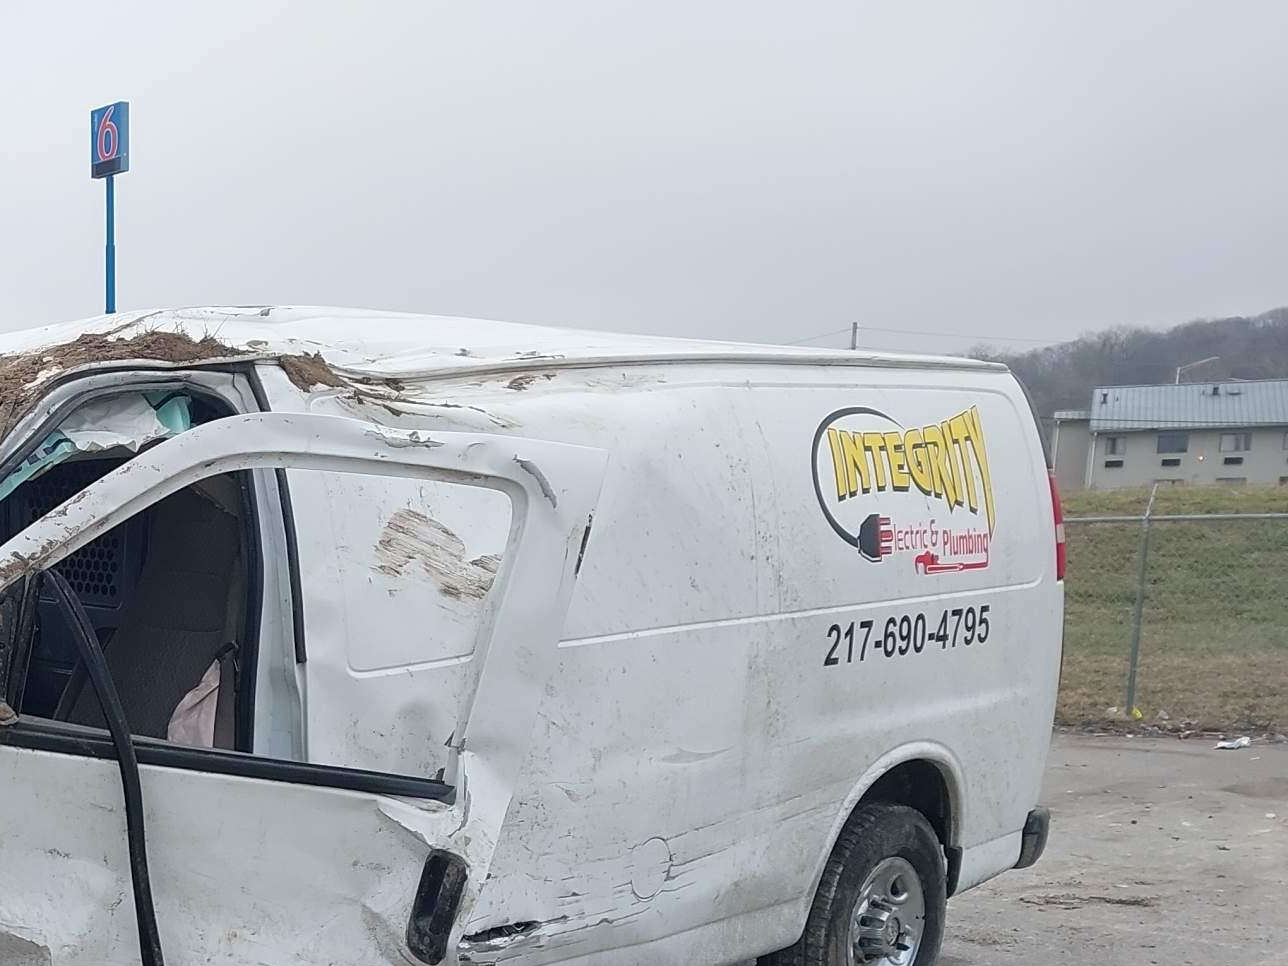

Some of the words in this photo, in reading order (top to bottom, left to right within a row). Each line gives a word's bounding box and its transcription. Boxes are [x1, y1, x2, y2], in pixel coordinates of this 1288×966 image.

[97, 105, 119, 161] 6
[826, 404, 996, 542] INTEGRITY
[942, 528, 989, 557] Plumbing
[823, 604, 991, 667] 217-690-4795
